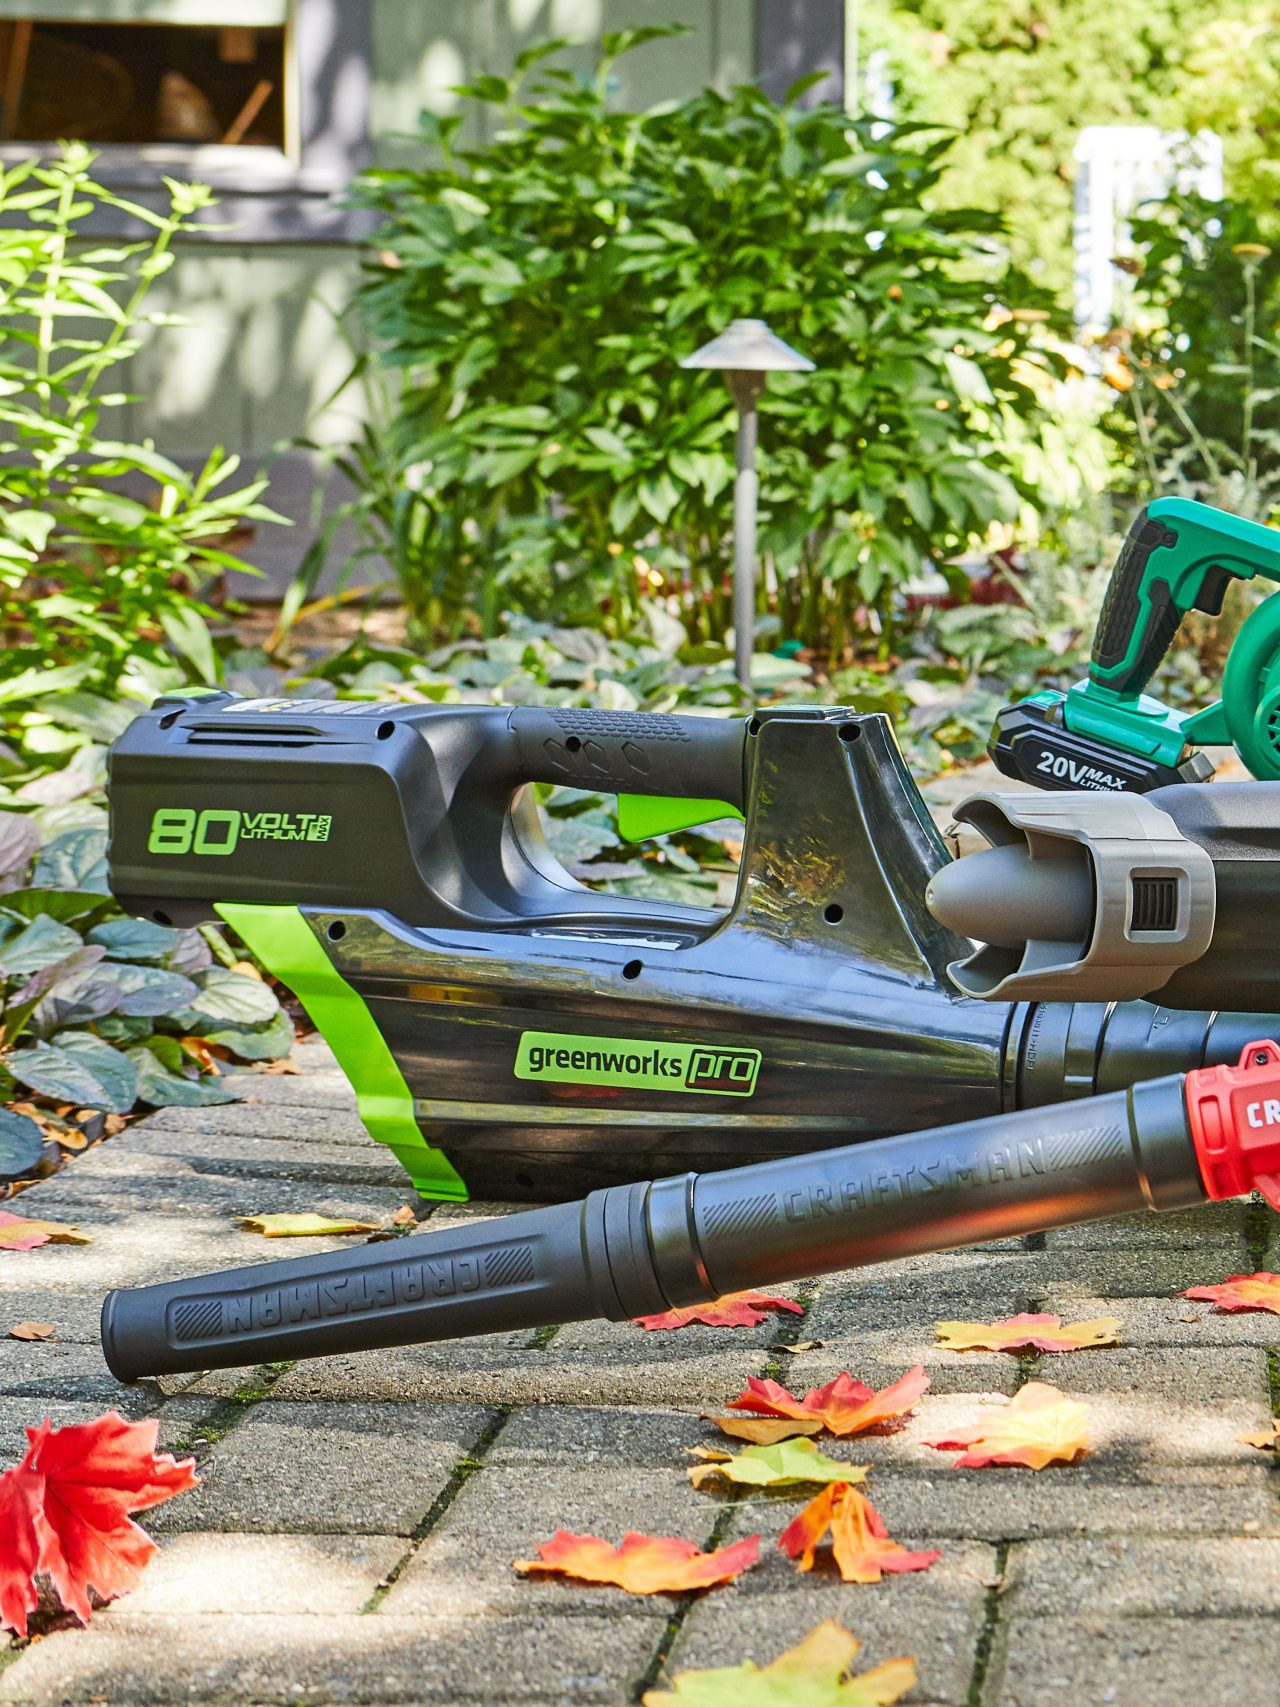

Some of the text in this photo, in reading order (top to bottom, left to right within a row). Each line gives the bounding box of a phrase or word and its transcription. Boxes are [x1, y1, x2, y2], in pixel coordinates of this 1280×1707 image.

[1036, 751, 1127, 790] 20V MAX
[1080, 779, 1115, 791] LITHI
[148, 808, 331, 855] 80 VOLT MAX
[240, 828, 305, 841] LITHIUM
[528, 1046, 756, 1084] greenworks pro
[781, 1138, 1046, 1223] CRAFTSMAN
[228, 1258, 481, 1334] CRAFTSMAN
